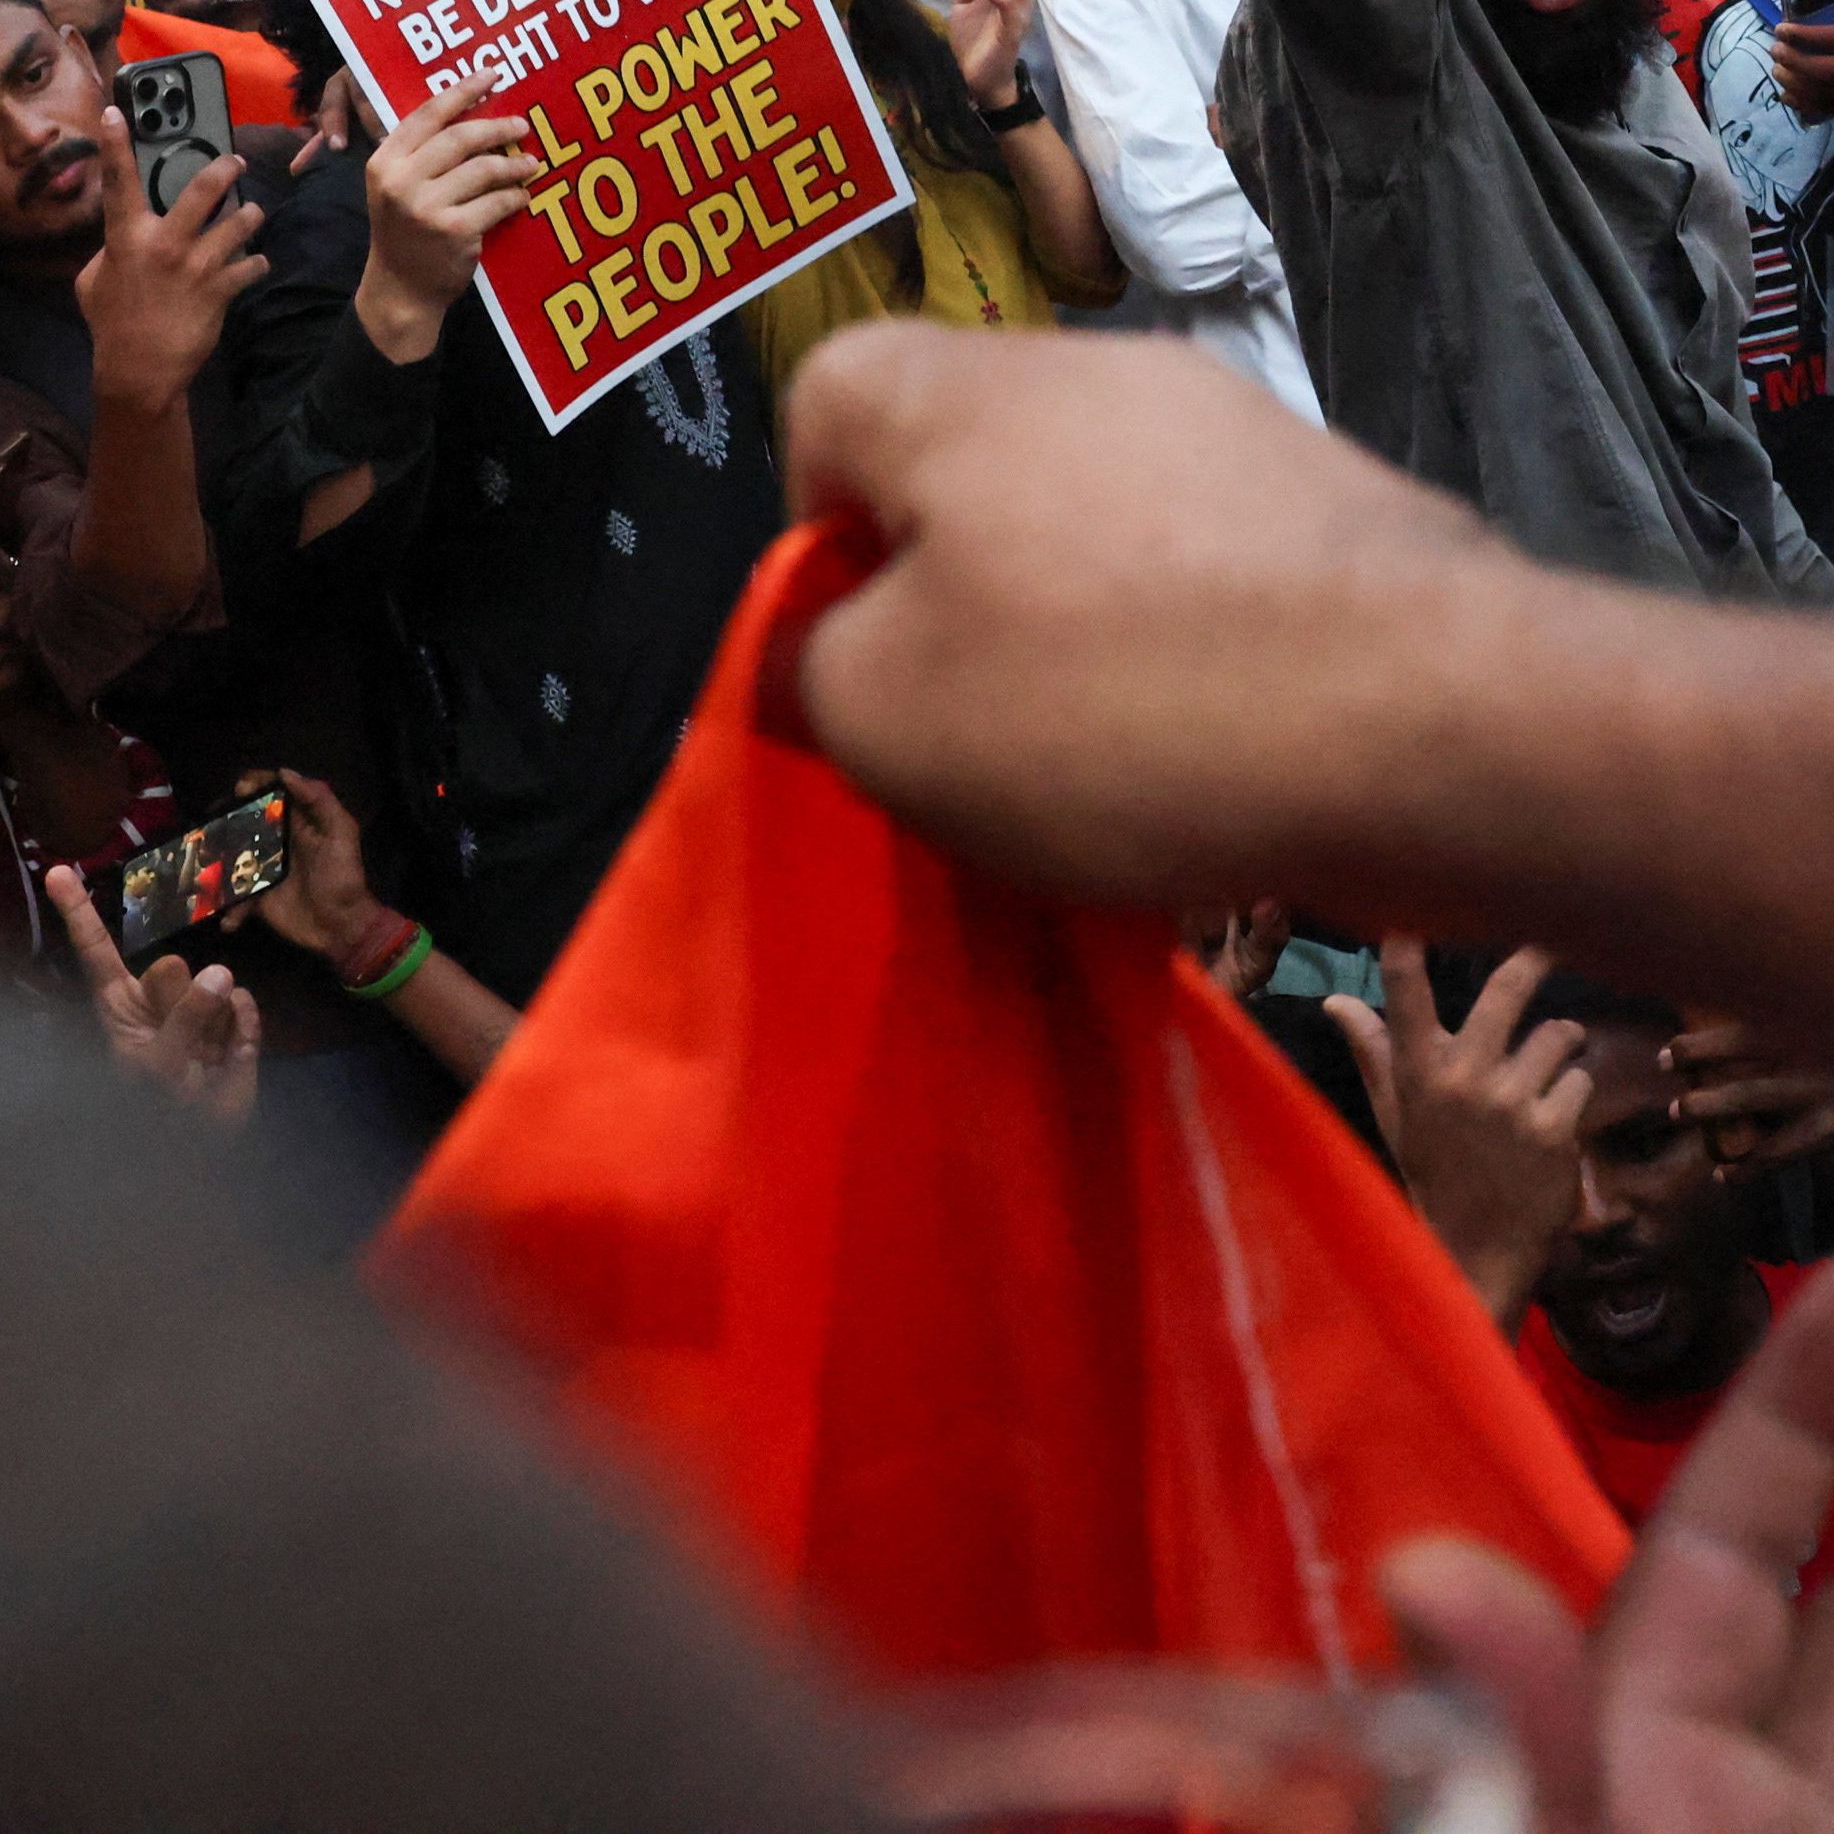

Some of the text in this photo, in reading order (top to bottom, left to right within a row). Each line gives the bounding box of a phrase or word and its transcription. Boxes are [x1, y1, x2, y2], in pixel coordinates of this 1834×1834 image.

[528, 59, 798, 265] TO THE
[543, 125, 857, 372] PEOPLE!
